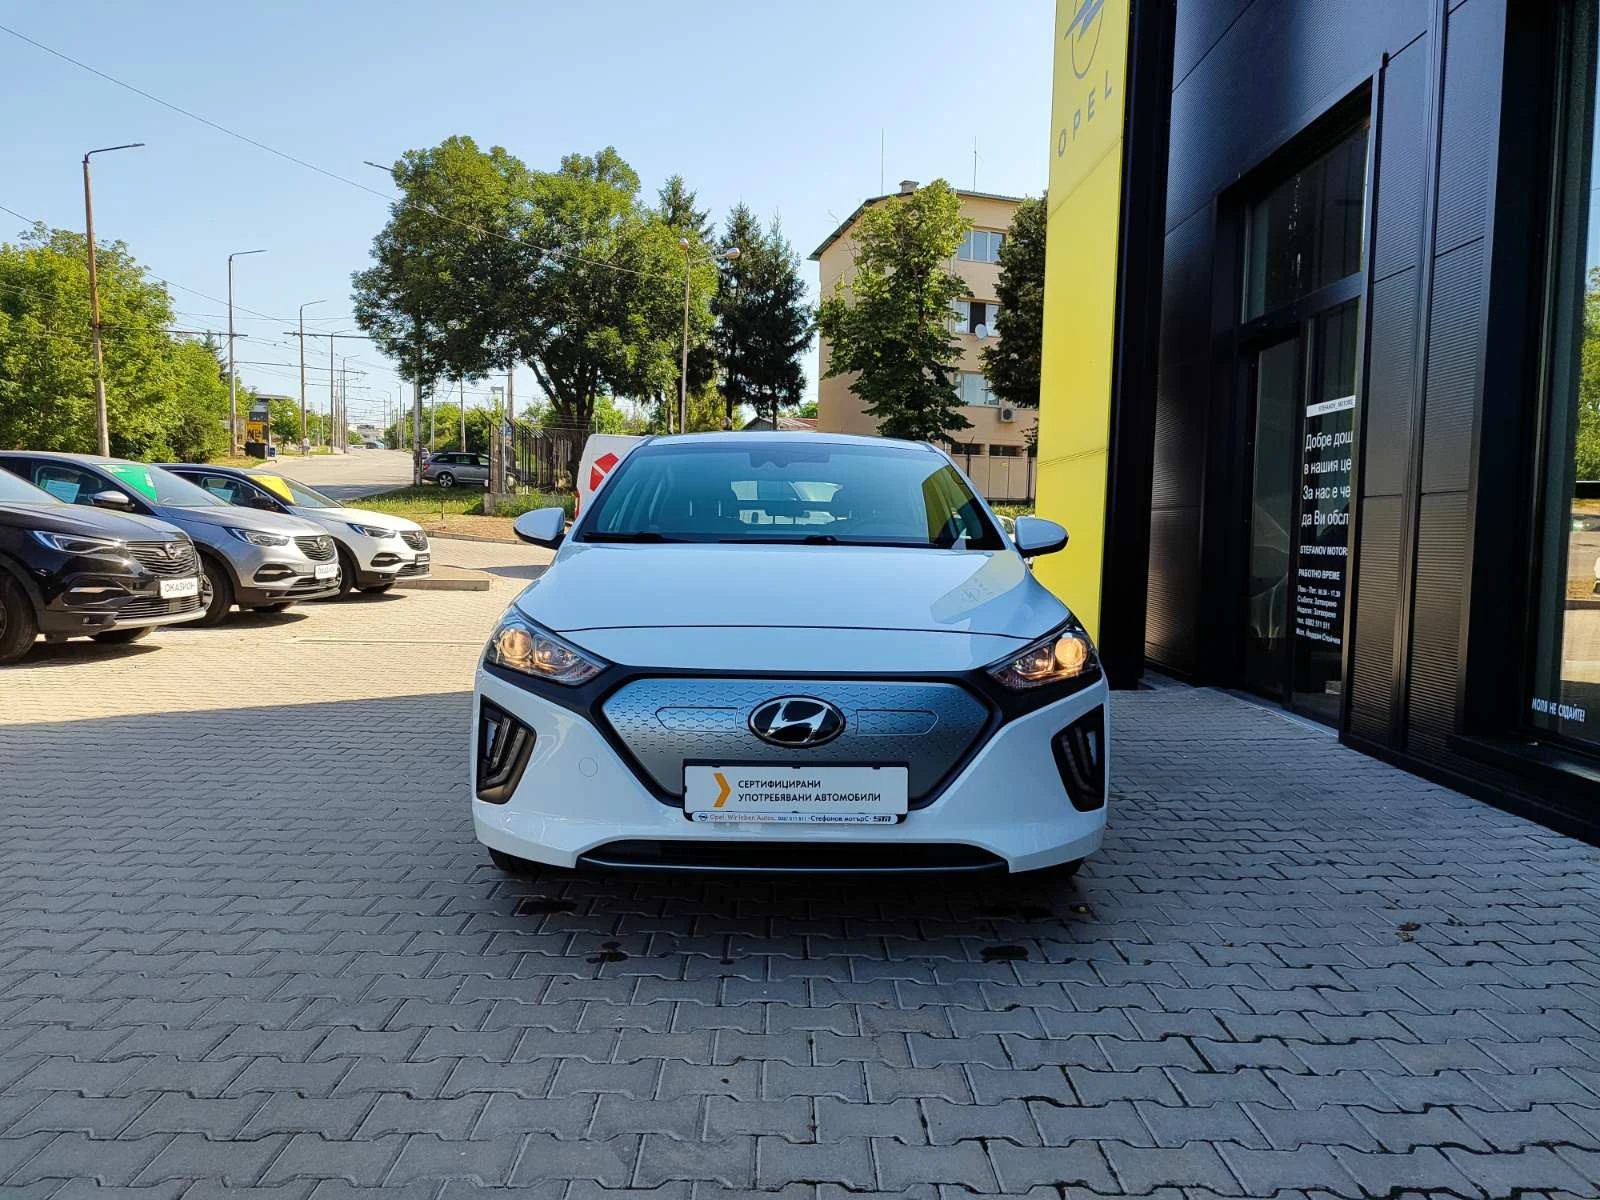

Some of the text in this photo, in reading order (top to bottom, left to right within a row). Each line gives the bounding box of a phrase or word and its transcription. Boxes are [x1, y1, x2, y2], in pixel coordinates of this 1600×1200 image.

[1058, 70, 1112, 158] OPEL
[1305, 432, 1332, 452] Добре
[1303, 458, 1352, 475] в нашия це
[1302, 485, 1351, 500] За нас е че
[1301, 513, 1313, 528] да
[1314, 510, 1326, 525] Ви
[1300, 545, 1327, 555] STEFANOV
[1298, 568, 1341, 581] РАБОТНО ВРЕМЕ
[1531, 697, 1548, 713] МОЛЯ
[1549, 702, 1557, 716] НЕ
[738, 780, 821, 789] СЕРТИФИЦИРАНИ
[738, 793, 881, 802] УПОТРЕБЯВАНИ АВТОМОБИЛИ
